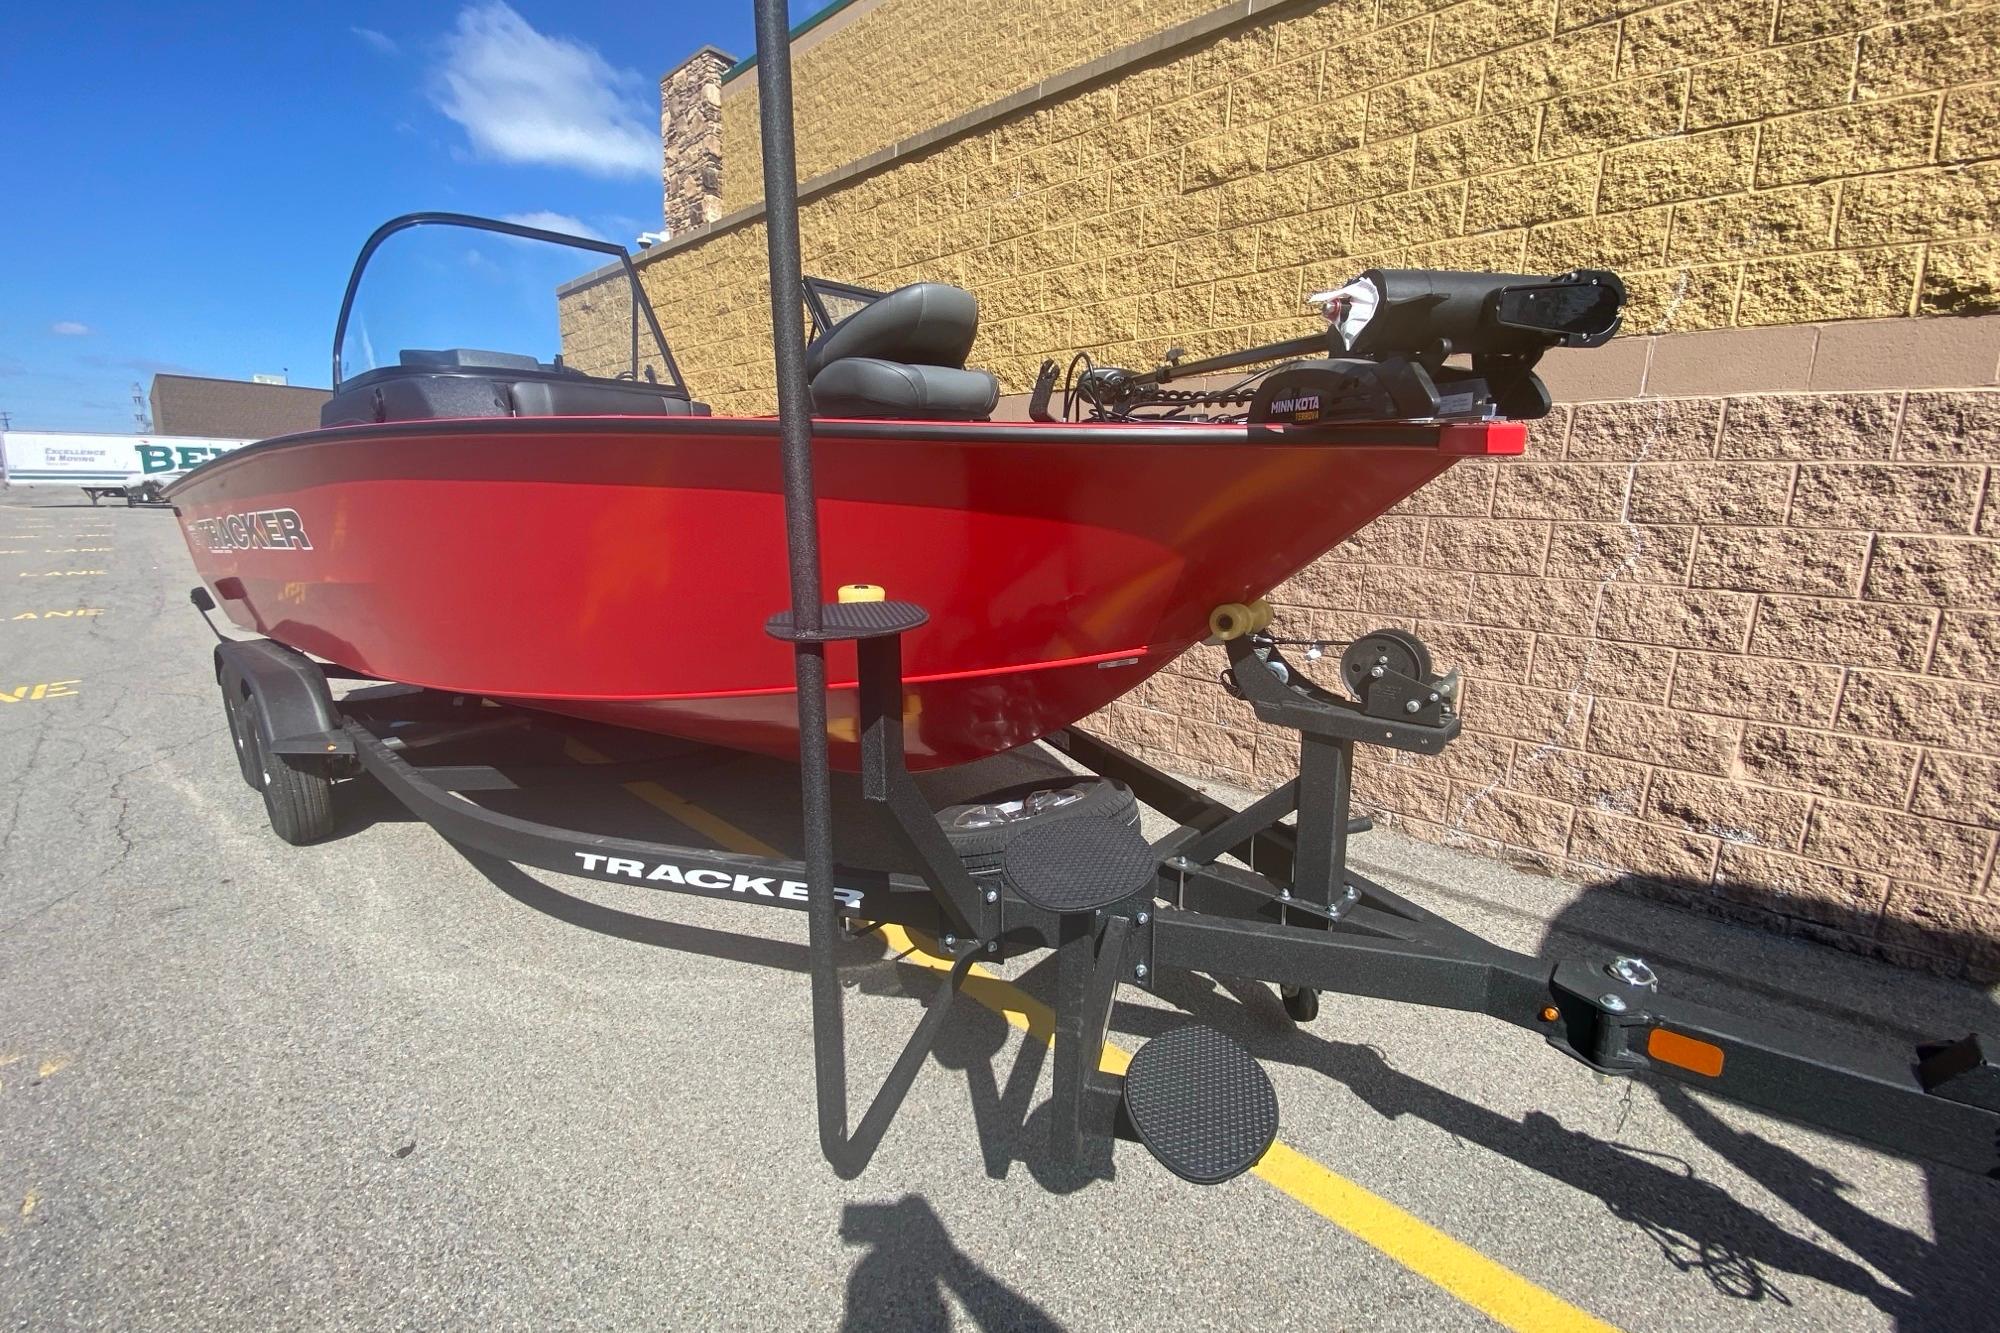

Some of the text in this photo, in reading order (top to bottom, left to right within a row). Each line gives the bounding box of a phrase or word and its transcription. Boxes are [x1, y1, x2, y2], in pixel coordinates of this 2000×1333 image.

[1271, 396, 1319, 414] MINN KOTA
[134, 444, 222, 475] BE
